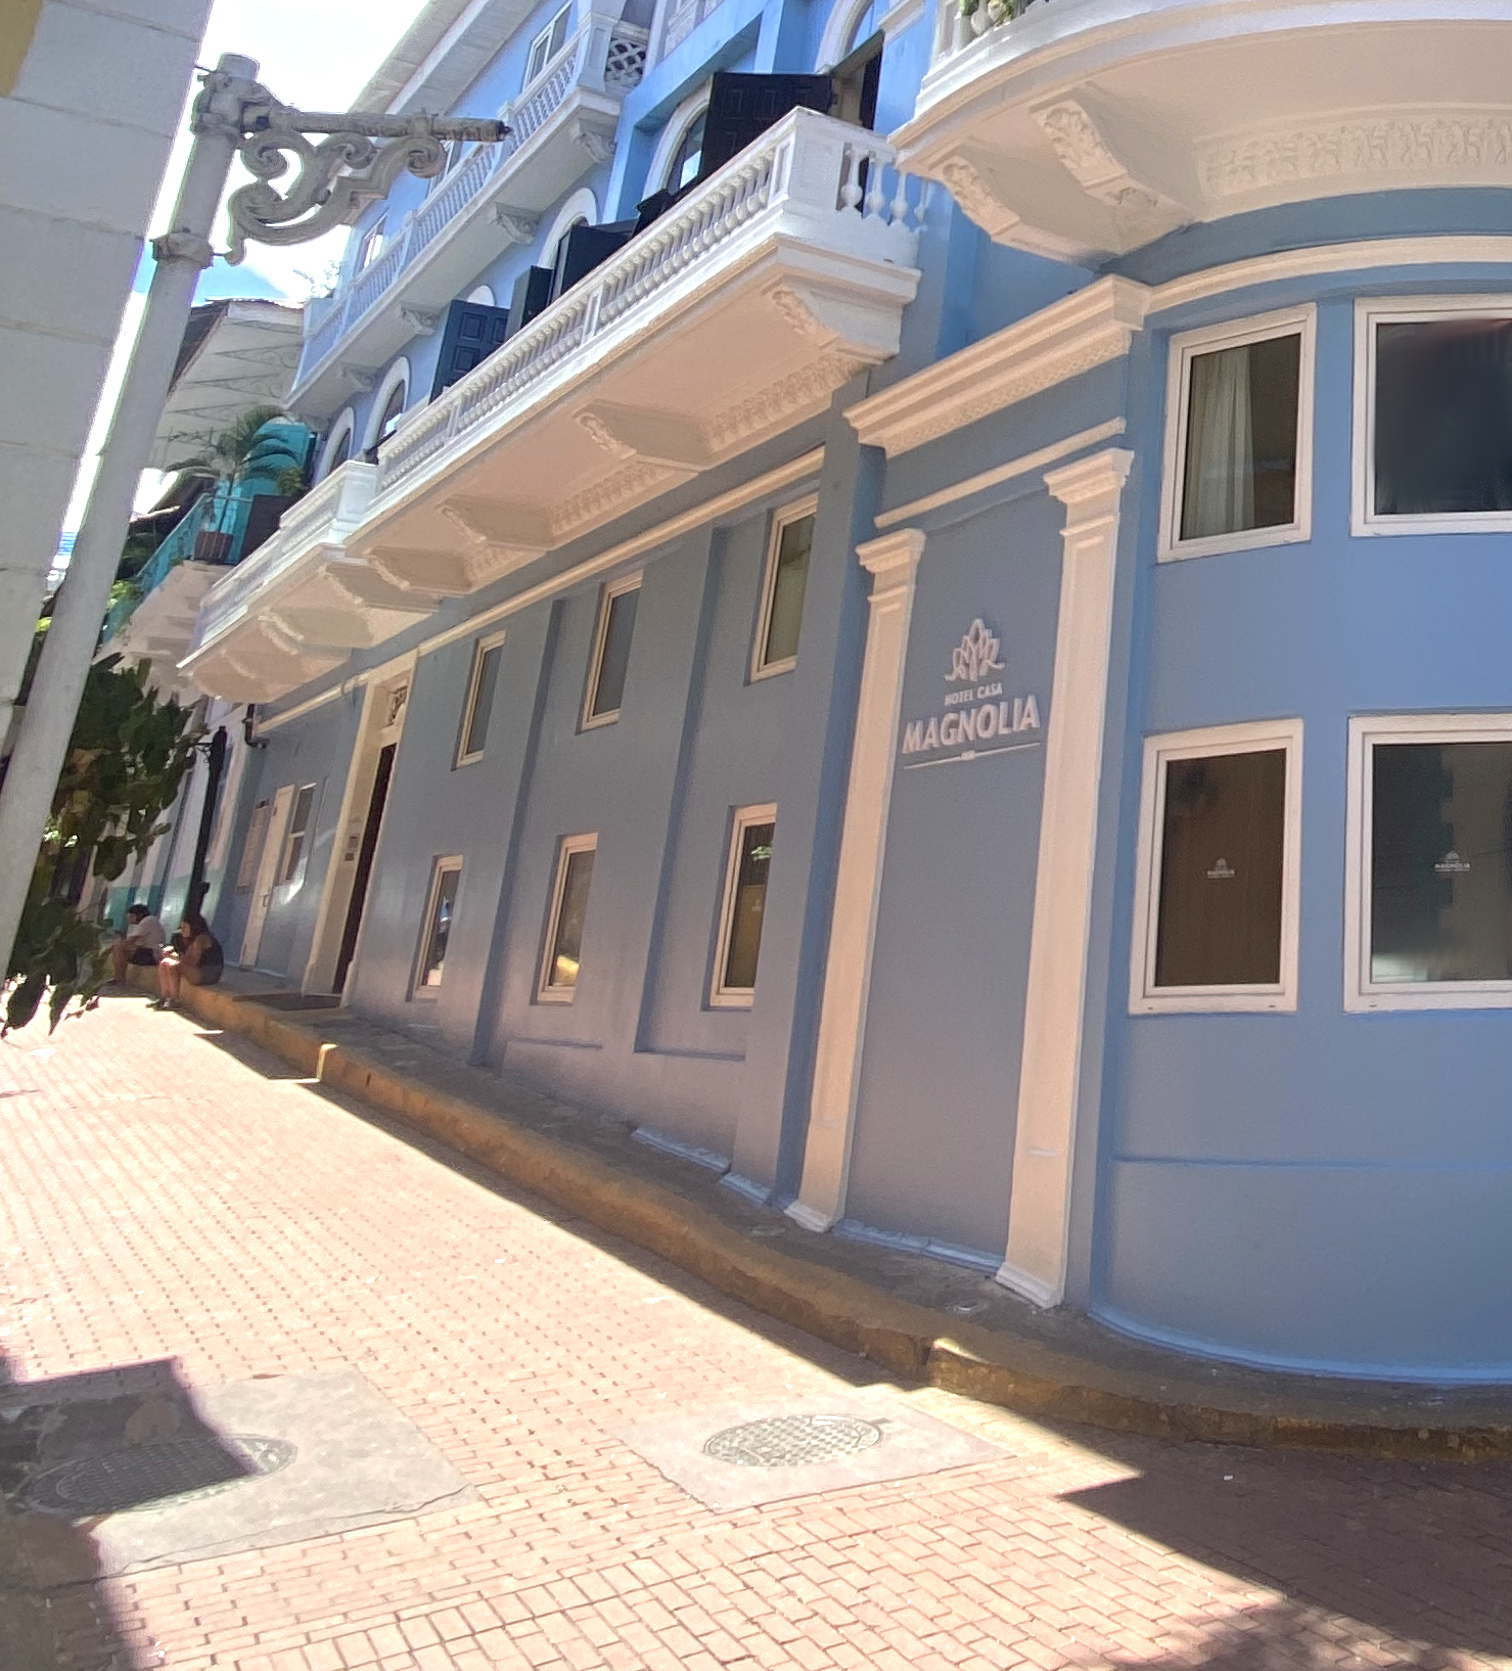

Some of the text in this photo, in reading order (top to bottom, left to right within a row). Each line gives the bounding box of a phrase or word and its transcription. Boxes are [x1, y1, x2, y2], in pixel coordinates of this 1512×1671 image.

[944, 682, 1003, 707] HOTEL CASA
[902, 694, 1041, 754] MAGNOLIA
